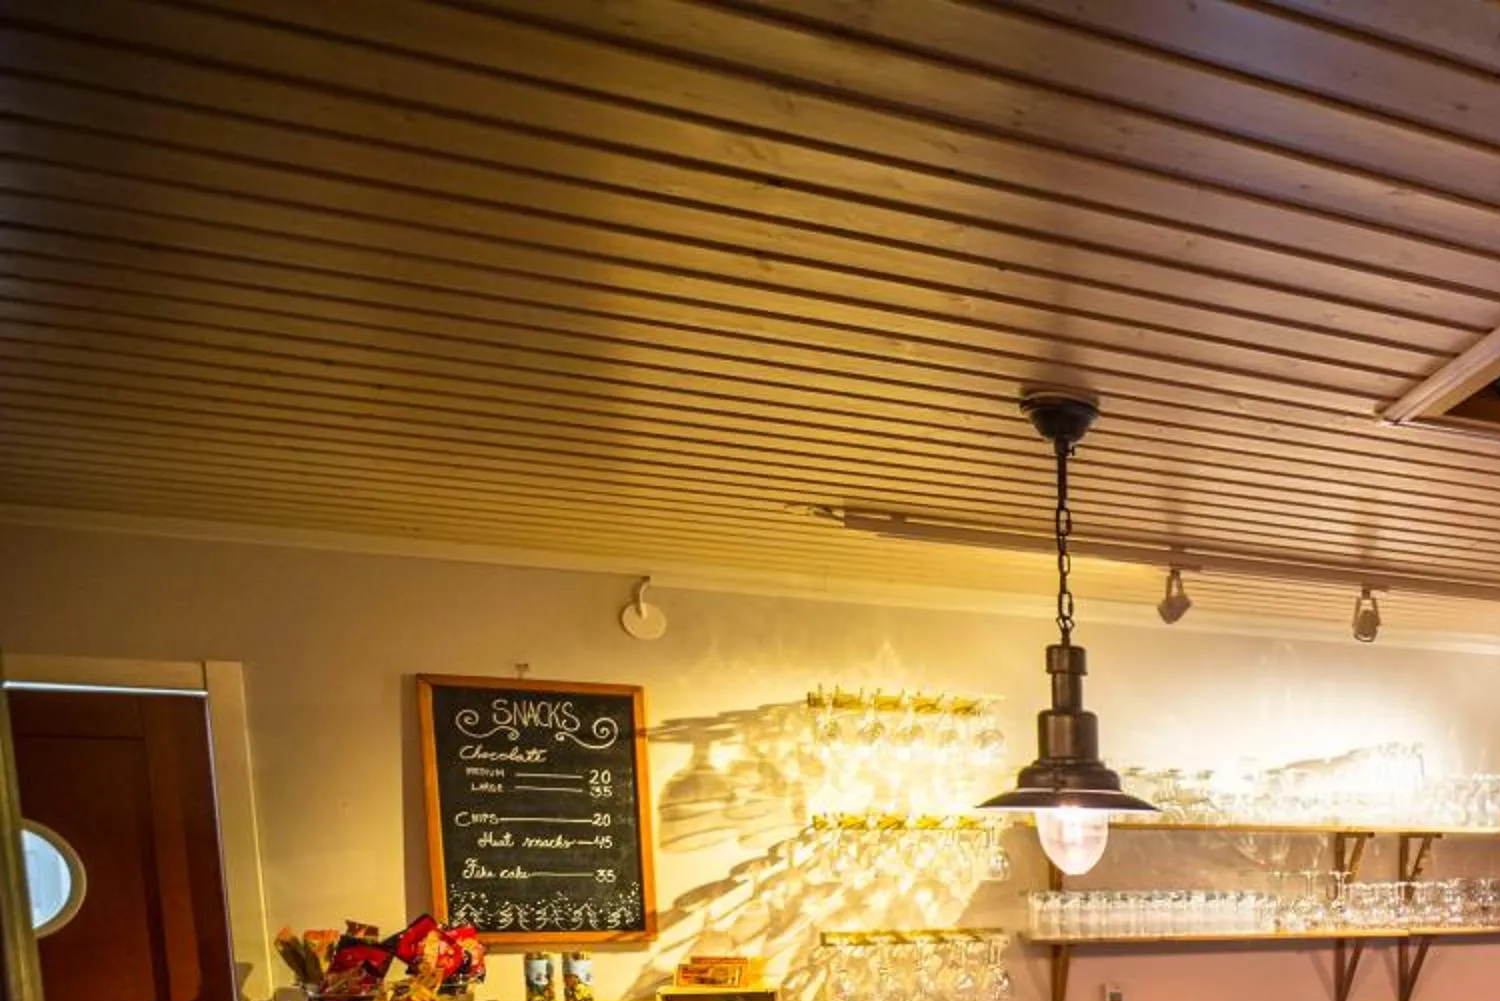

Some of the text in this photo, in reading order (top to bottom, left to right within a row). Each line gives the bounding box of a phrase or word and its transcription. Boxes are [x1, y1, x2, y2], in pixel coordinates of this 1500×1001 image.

[492, 699, 581, 732] SNACKS
[459, 743, 548, 763] Chocolate
[588, 769, 612, 785] 20
[471, 781, 613, 798] LARGE 35
[455, 811, 611, 827] CHIPS 20
[593, 835, 613, 849] 45
[594, 869, 617, 883] 35
